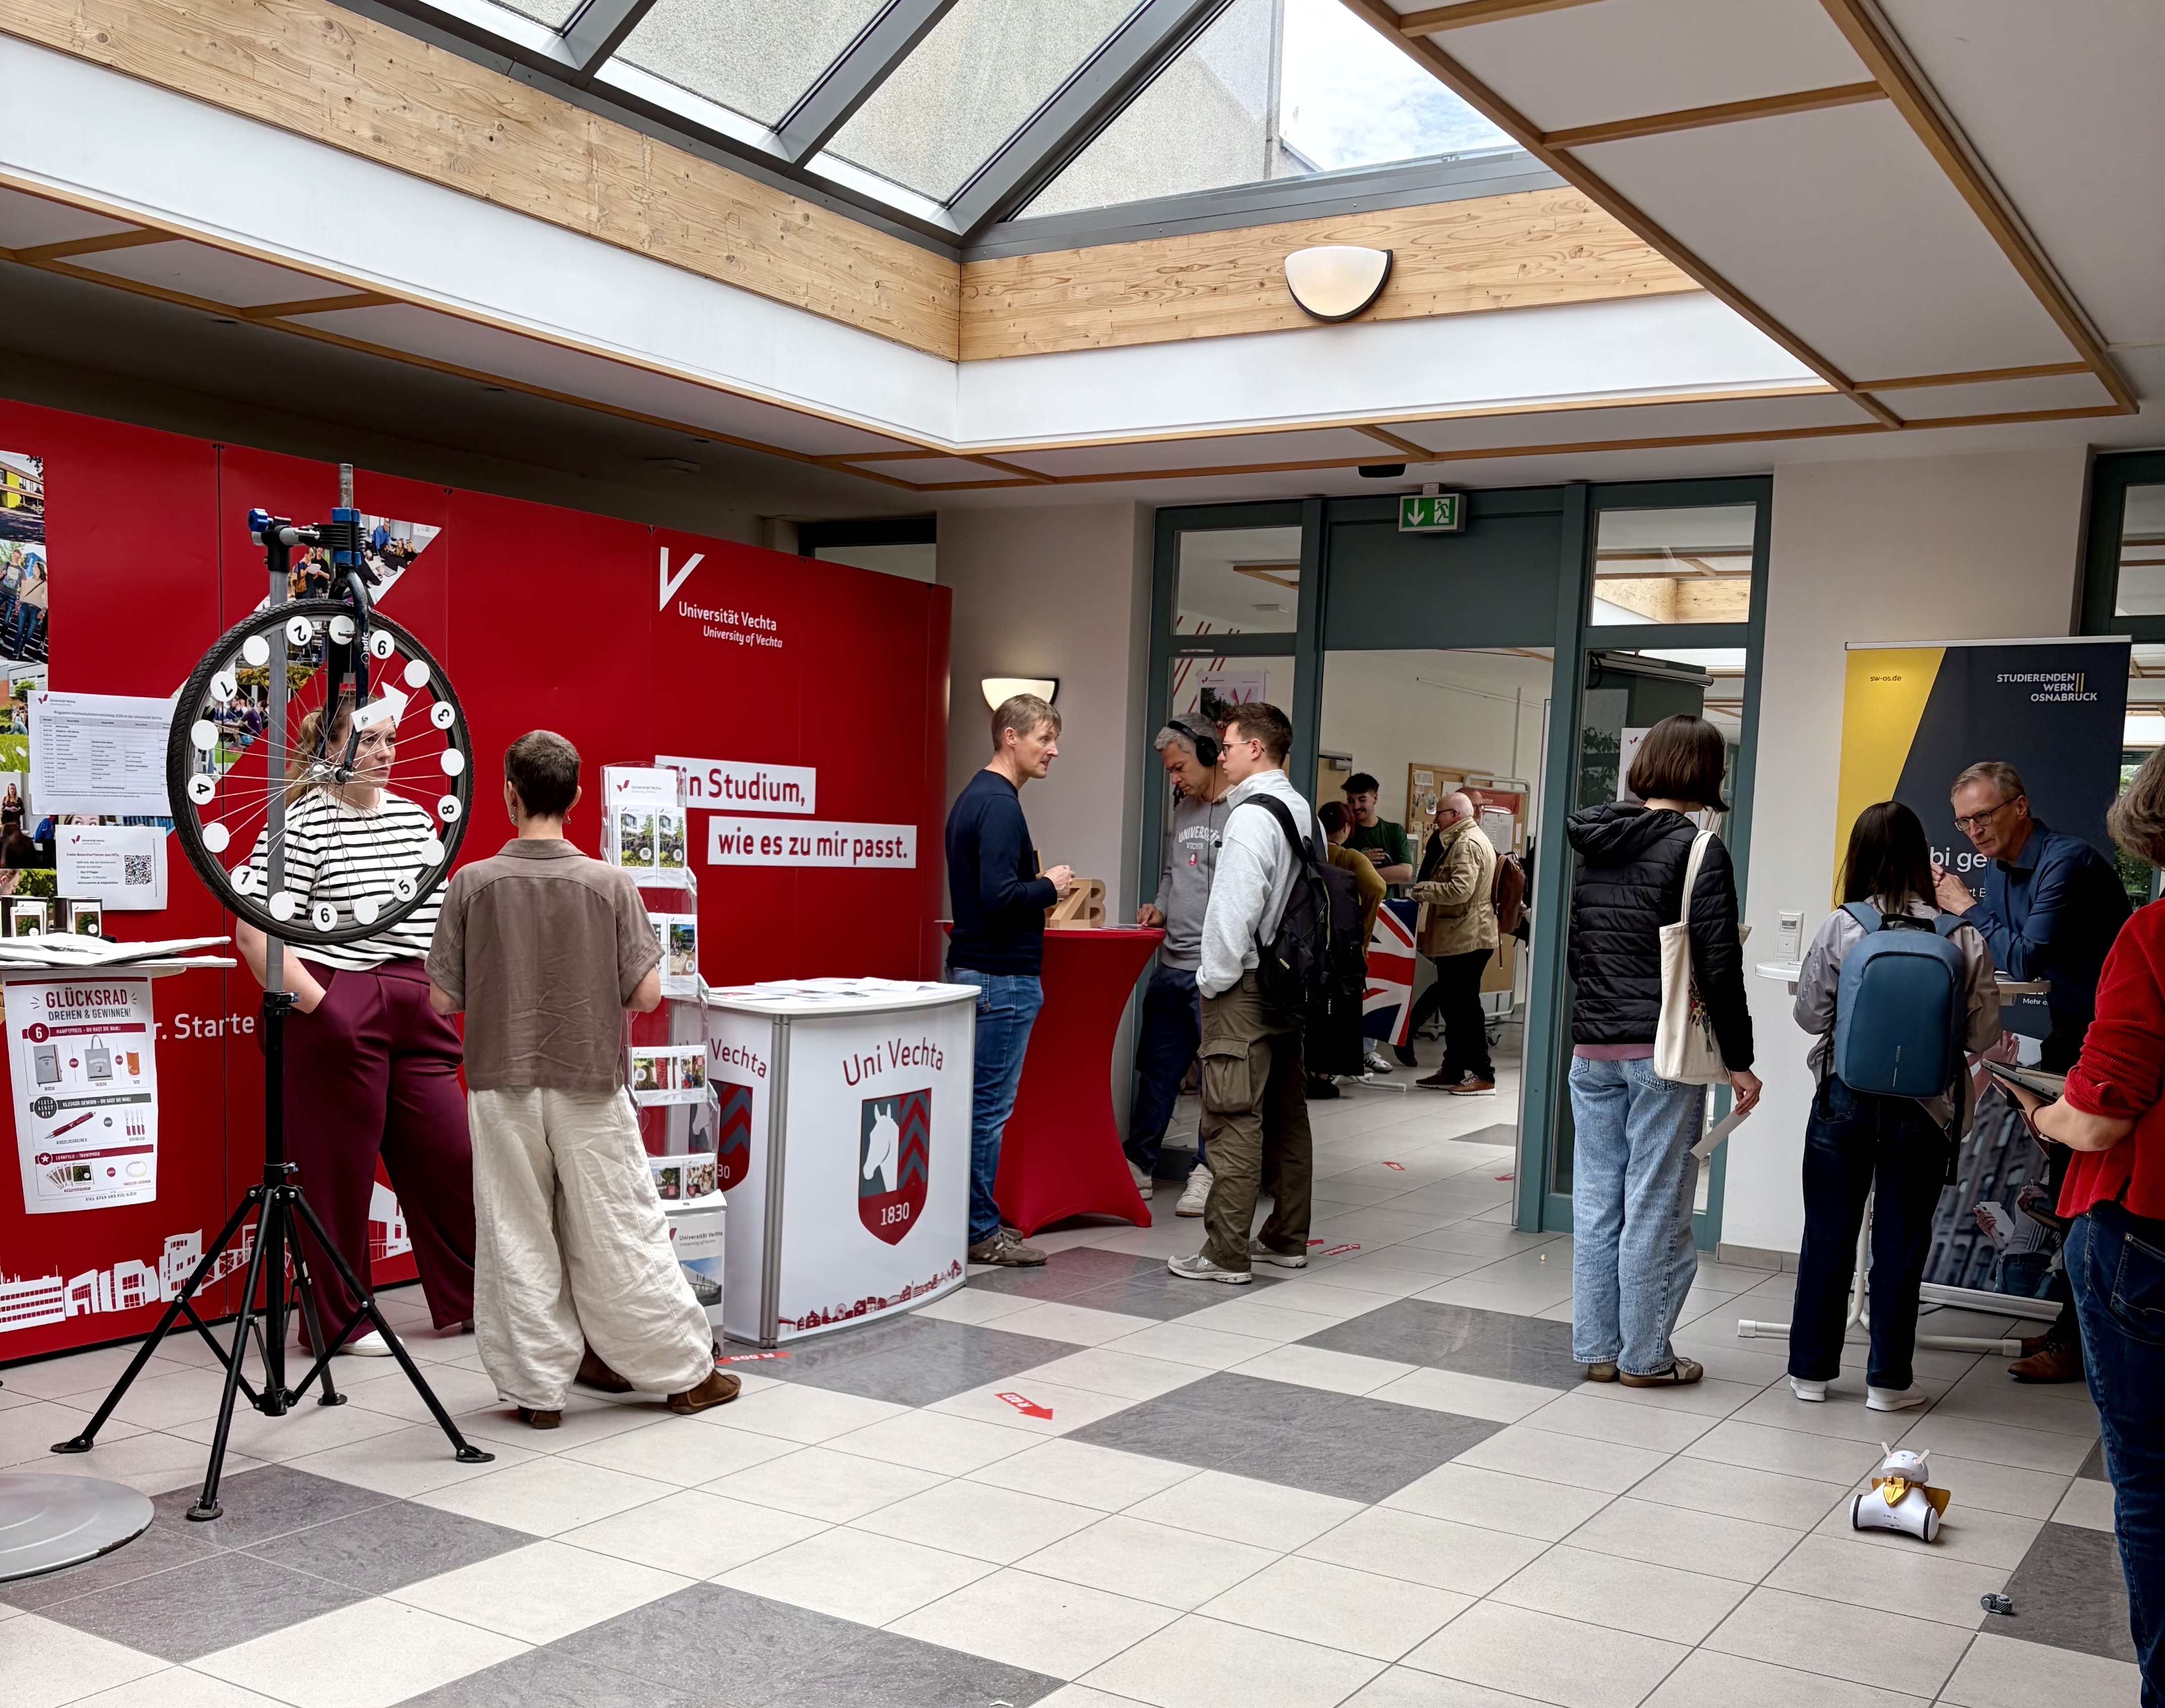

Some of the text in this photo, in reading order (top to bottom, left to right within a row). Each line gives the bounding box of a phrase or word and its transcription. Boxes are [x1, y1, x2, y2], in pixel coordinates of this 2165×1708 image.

[679, 601, 777, 631] Universität Vechta
[703, 625, 783, 648] University of Vechta
[1997, 673, 2076, 683] STUDIERENDEN
[2043, 684, 2074, 692] WERK
[708, 768, 805, 807] Studium,
[718, 827, 908, 865] wie es zu mir passt.
[1930, 846, 1988, 872] bi ge
[398, 879, 410, 894] 5
[321, 908, 330, 923] 6
[46, 987, 127, 1008] GLÜCKSRAD
[49, 1008, 131, 1021] DREHEN & GEWINNEN!
[174, 1013, 254, 1039] Starte
[35, 1026, 42, 1039] 6
[711, 1038, 767, 1078] Vechta
[843, 1037, 943, 1086] Uni Vechta
[717, 1164, 730, 1179] 30
[881, 1201, 910, 1226] 1830
